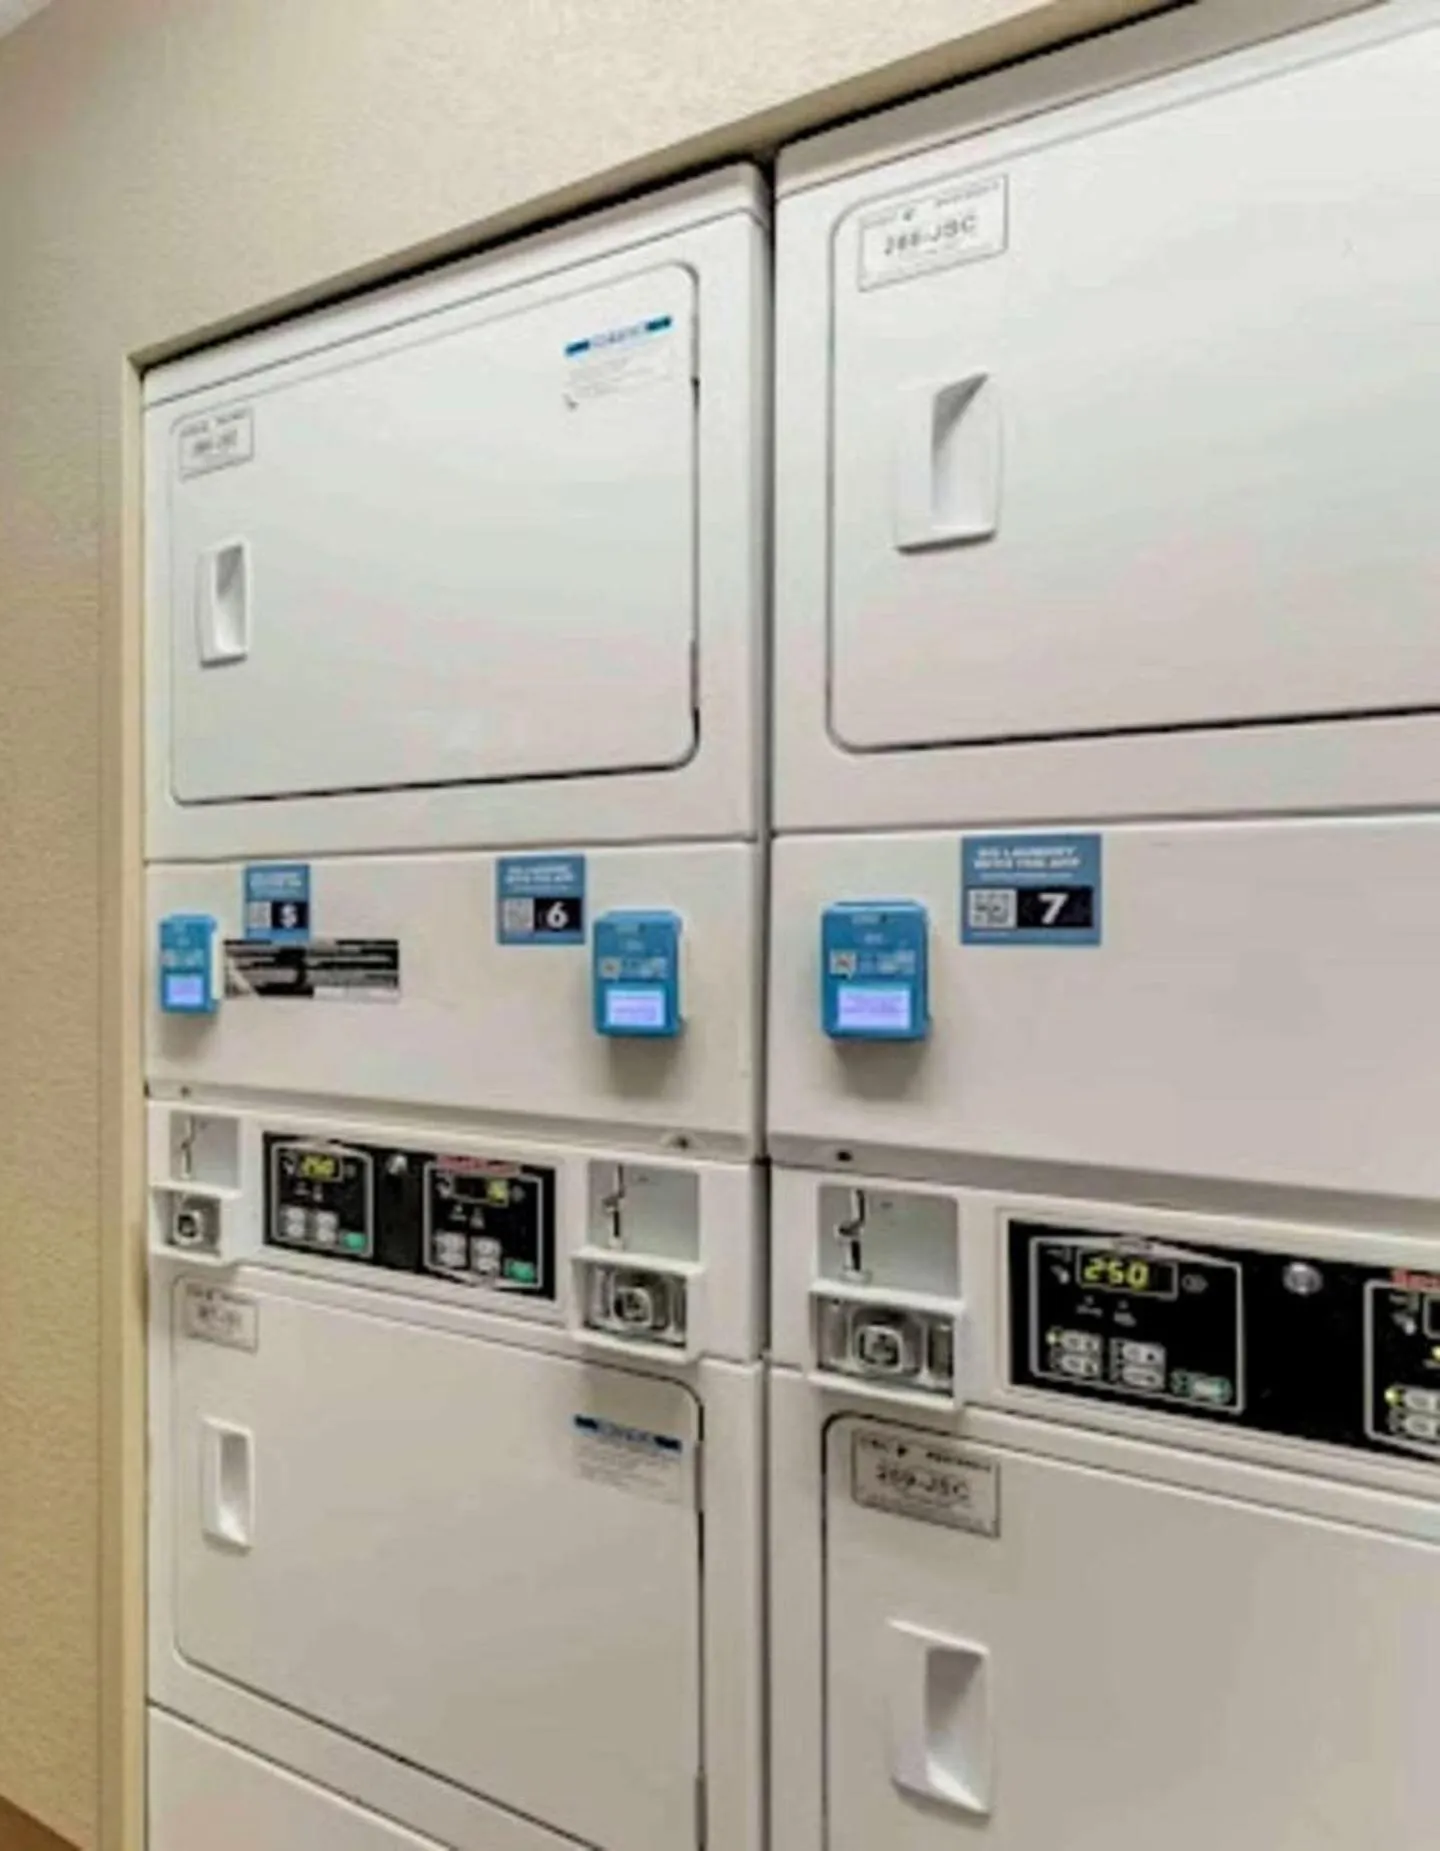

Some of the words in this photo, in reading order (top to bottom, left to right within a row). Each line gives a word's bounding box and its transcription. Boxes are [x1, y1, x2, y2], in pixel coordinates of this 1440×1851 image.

[546, 901, 569, 929] 6
[1038, 892, 1069, 925] 7
[1083, 1257, 1149, 1290] 250
